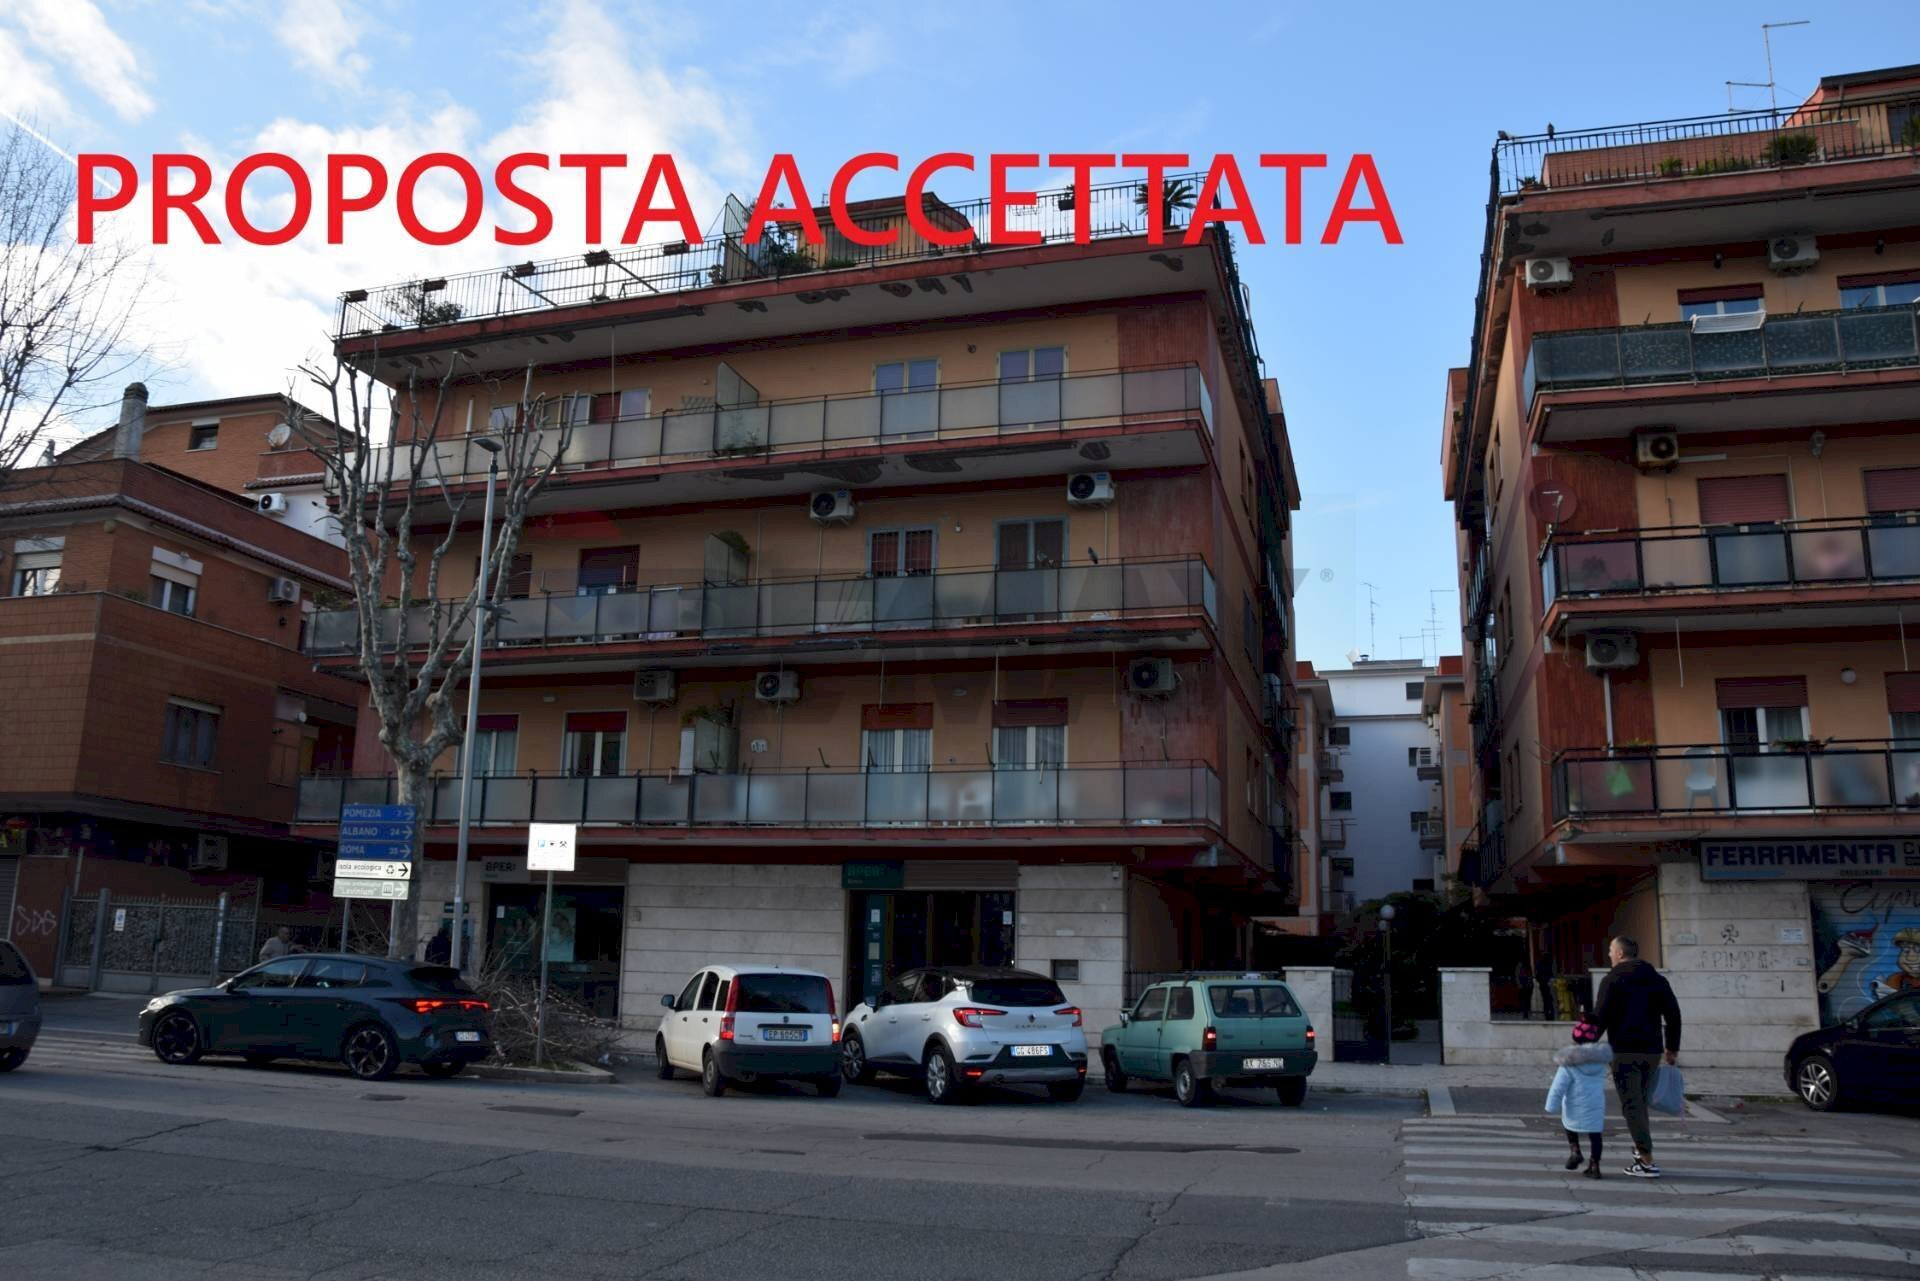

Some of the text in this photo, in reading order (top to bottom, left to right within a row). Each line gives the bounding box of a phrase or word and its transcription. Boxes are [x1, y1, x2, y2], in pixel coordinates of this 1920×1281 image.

[343, 808, 382, 819] POMEZIA
[342, 826, 378, 837] ALBANO
[339, 844, 365, 855] ROMA
[1706, 844, 1897, 866] FERRAMENTA
[338, 862, 382, 872] isola ecologica
